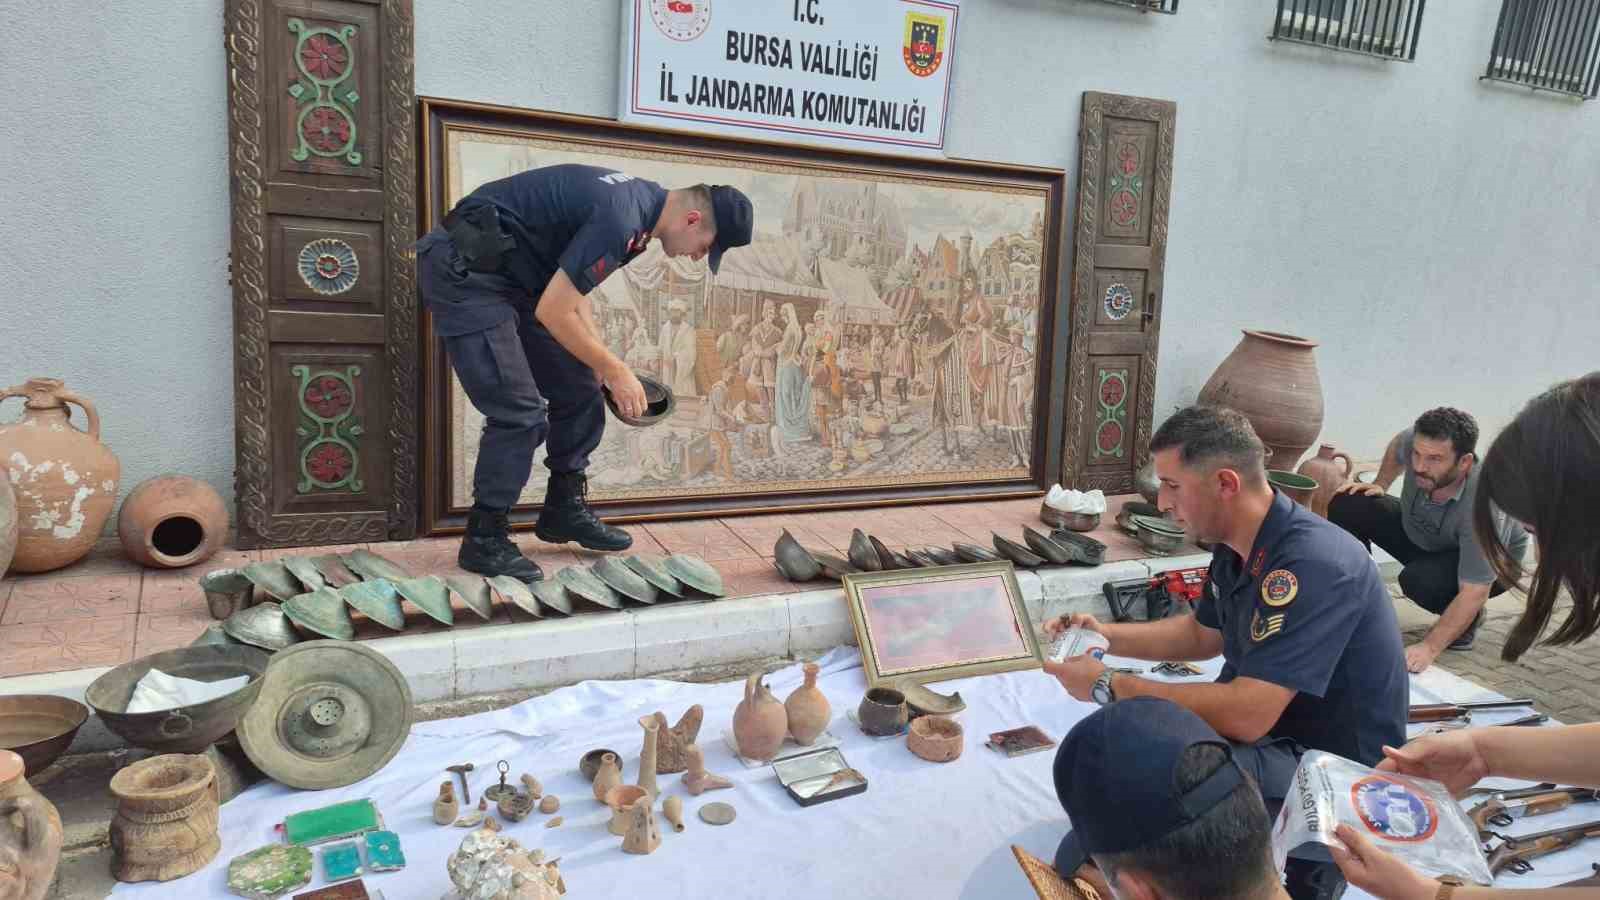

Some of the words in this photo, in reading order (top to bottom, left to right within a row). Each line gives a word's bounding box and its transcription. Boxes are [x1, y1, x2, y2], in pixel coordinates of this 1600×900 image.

[726, 30, 793, 69] BURSA
[800, 39, 879, 82] VALİLİĞİ
[659, 62, 679, 103] İL
[685, 74, 796, 118] JANDARMA
[801, 89, 927, 134] KOMUTANLIĞI
